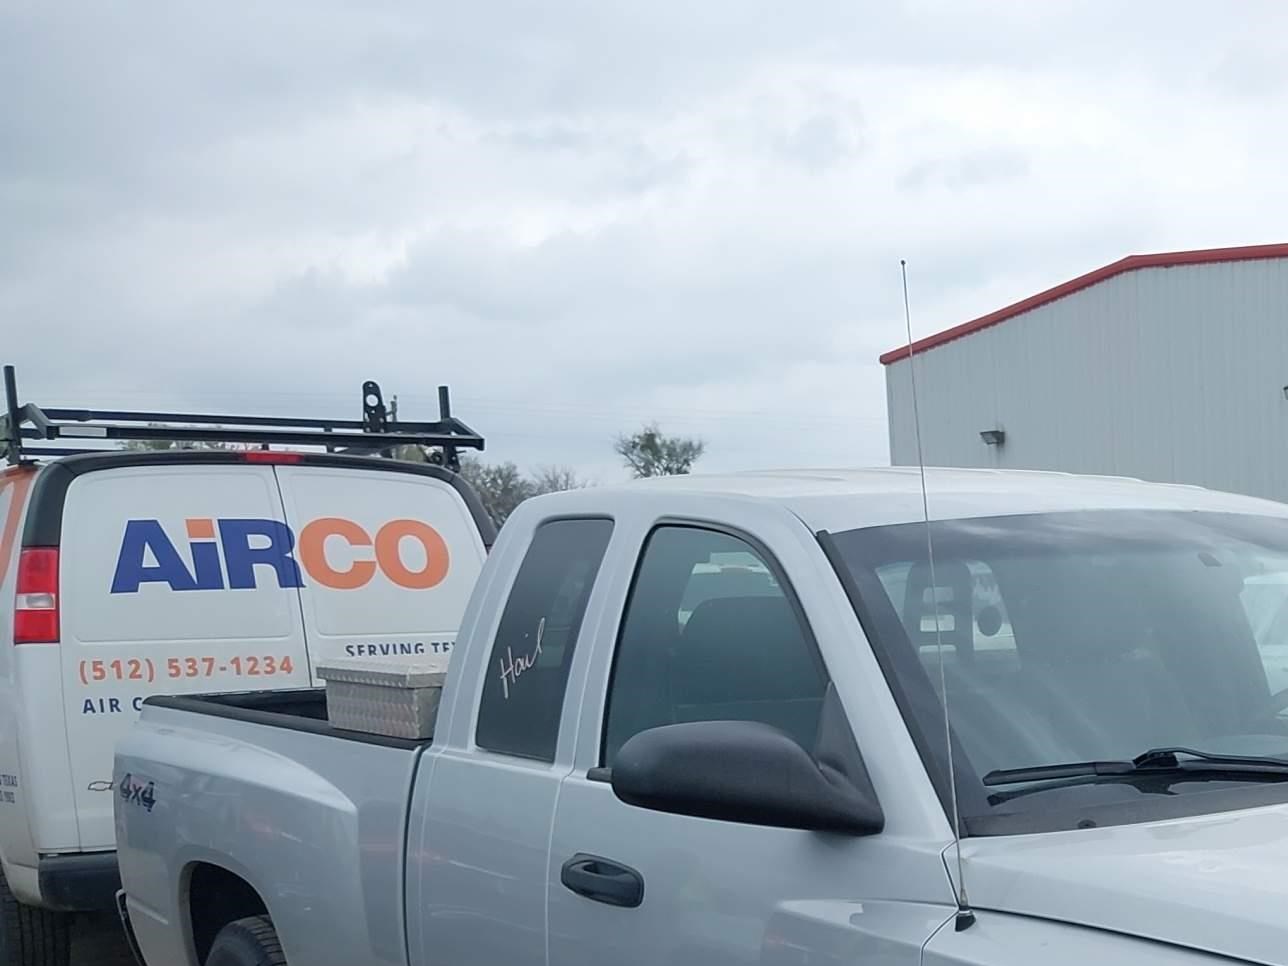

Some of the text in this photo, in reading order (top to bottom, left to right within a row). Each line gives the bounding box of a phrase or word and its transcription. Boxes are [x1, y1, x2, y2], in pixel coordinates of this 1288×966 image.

[345, 643, 424, 656] SERVING
[79, 656, 293, 685] (512) 537-1234
[82, 698, 122, 714] AIR
